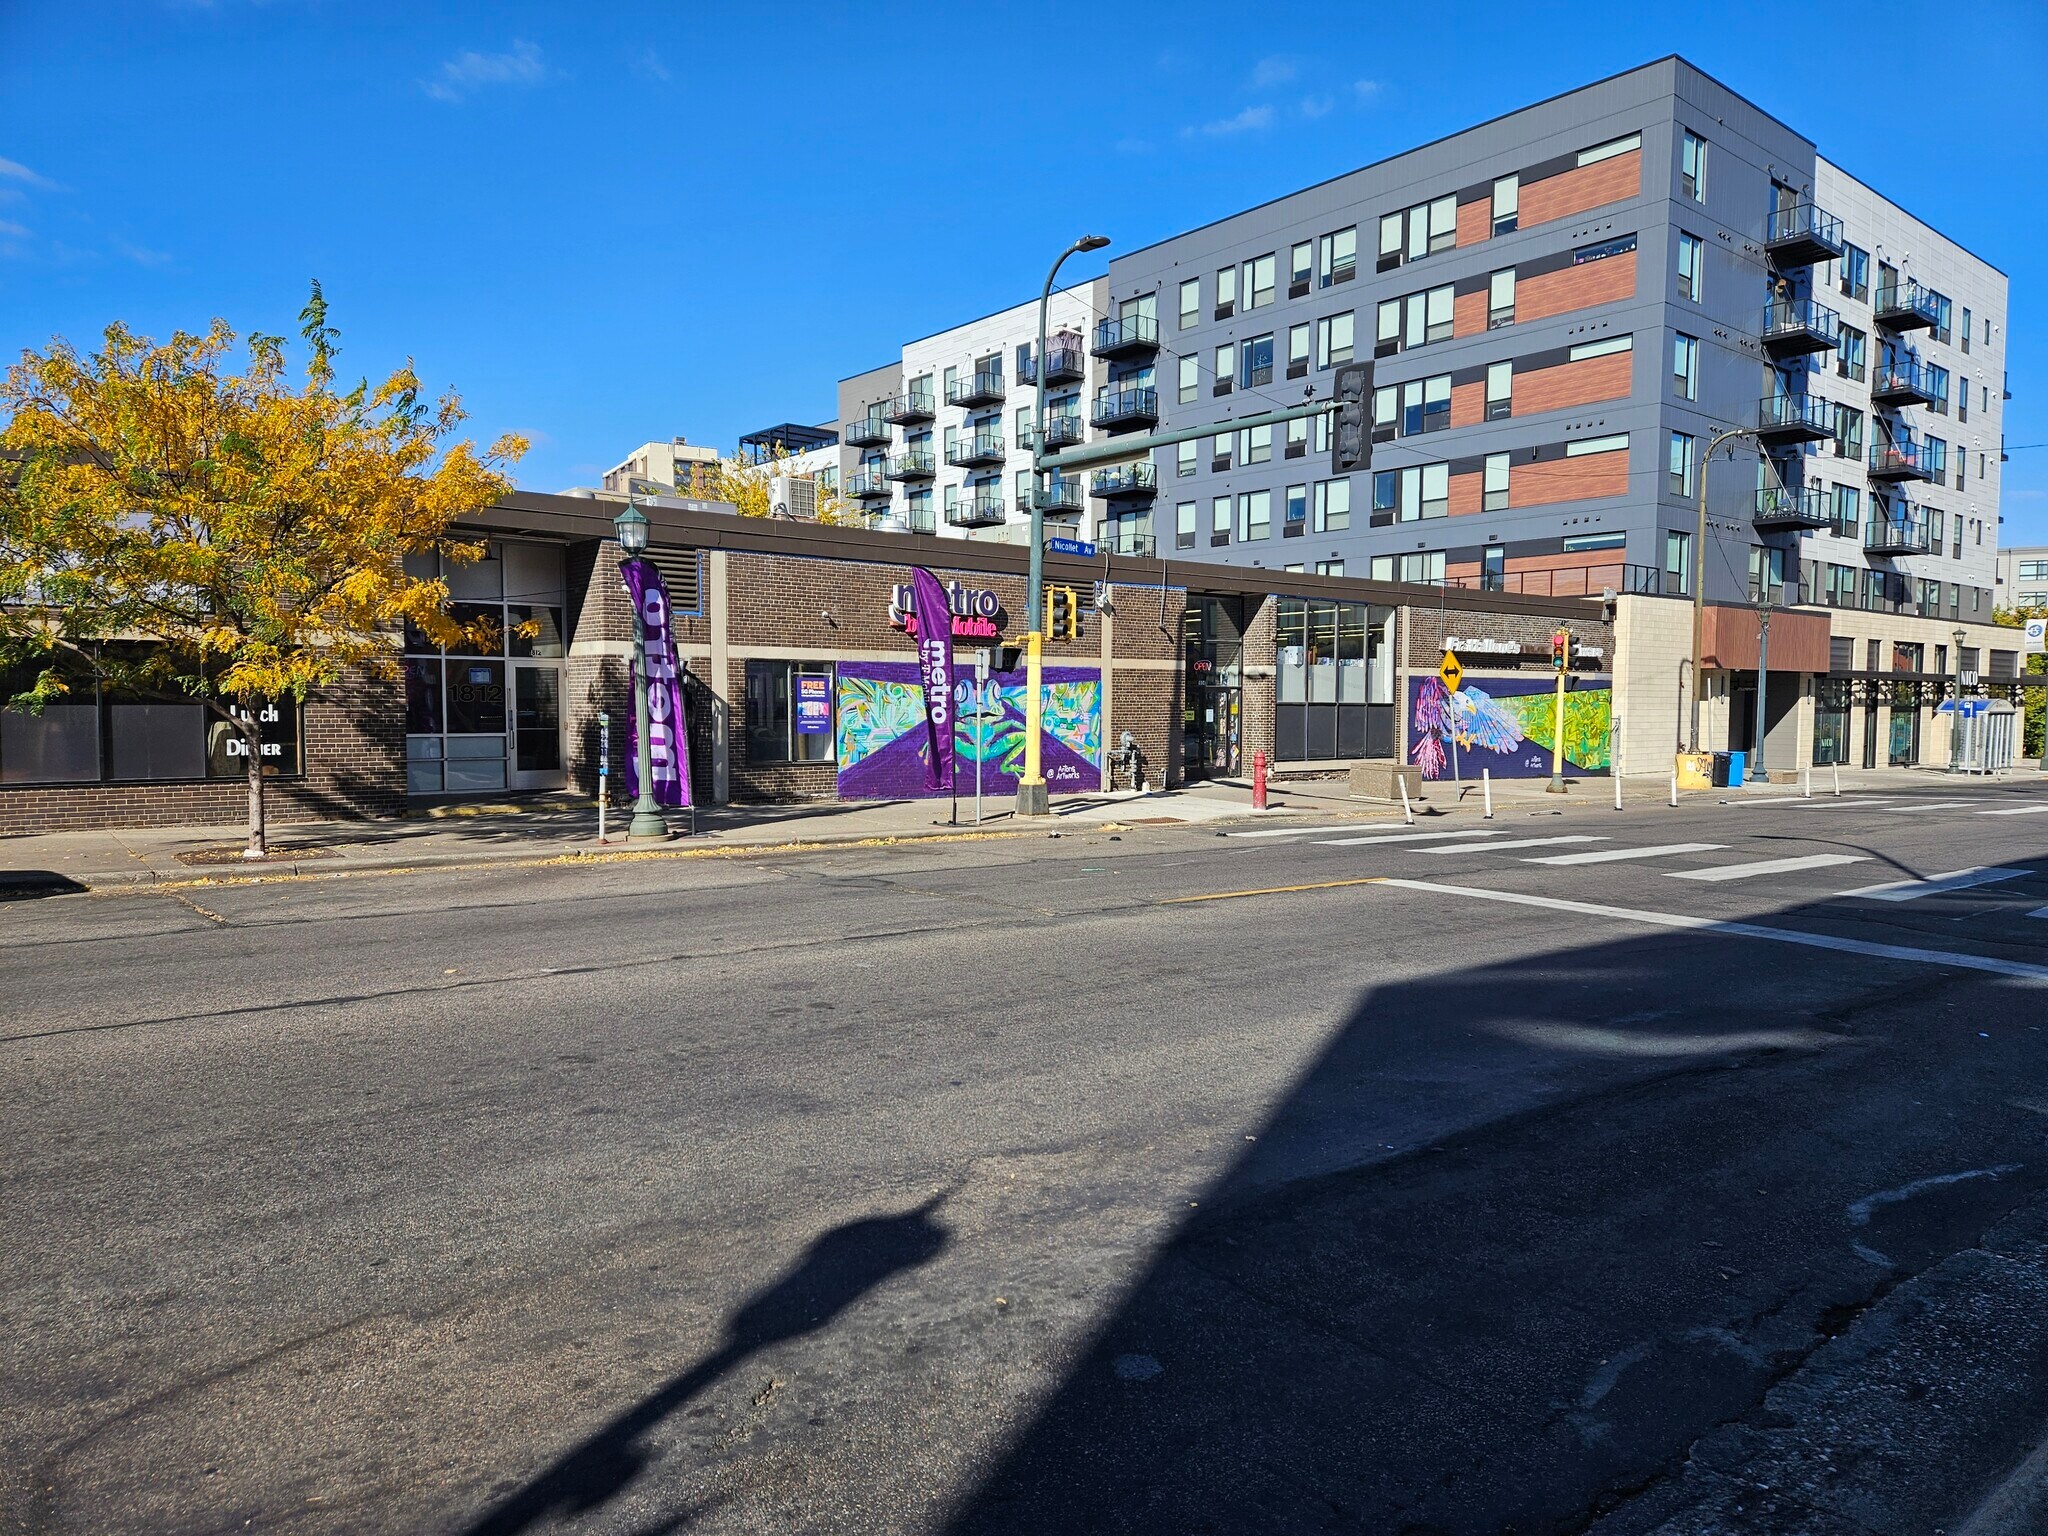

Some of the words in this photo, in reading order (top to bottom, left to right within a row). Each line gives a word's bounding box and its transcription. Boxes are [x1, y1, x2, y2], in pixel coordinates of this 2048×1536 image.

[1055, 540, 1079, 553] Nicollet
[892, 580, 999, 618] mtro
[1193, 661, 1212, 672] OPEN
[800, 680, 825, 690] FREE
[930, 640, 950, 725] metro
[1960, 670, 1978, 686] NICO
[448, 683, 504, 703] 1812
[229, 703, 279, 722] Luch
[1046, 768, 1055, 779] @
